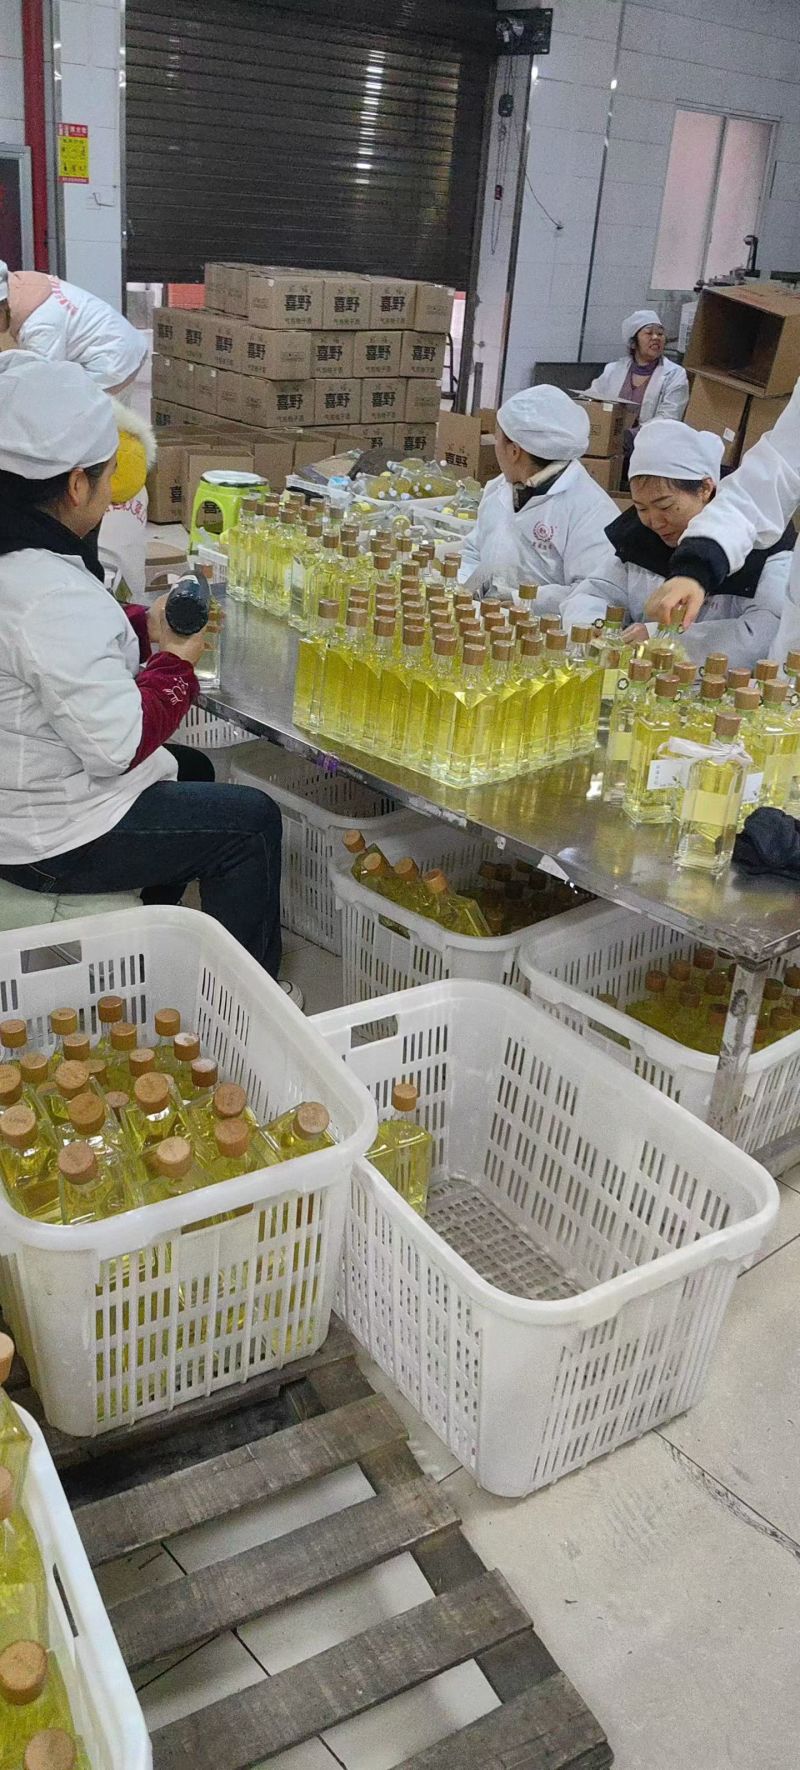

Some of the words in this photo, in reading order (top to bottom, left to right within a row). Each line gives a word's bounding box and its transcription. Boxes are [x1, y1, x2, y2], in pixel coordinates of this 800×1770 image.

[284, 294, 311, 312] 喜野
[334, 296, 360, 313] 喜野
[380, 295, 406, 312] 喜野
[157, 323, 173, 339] 喜野
[185, 329, 201, 346] 喜野
[215, 335, 233, 354] 喜野
[247, 342, 266, 361] 喜野
[365, 345, 391, 361] 喜野
[316, 345, 343, 362] 喜野
[412, 345, 436, 362] 喜野
[276, 393, 304, 411] 喜野
[324, 392, 351, 409] 喜野
[371, 391, 396, 408] 喜野
[403, 436, 427, 451] 喜野
[445, 452, 468, 468] 喜野
